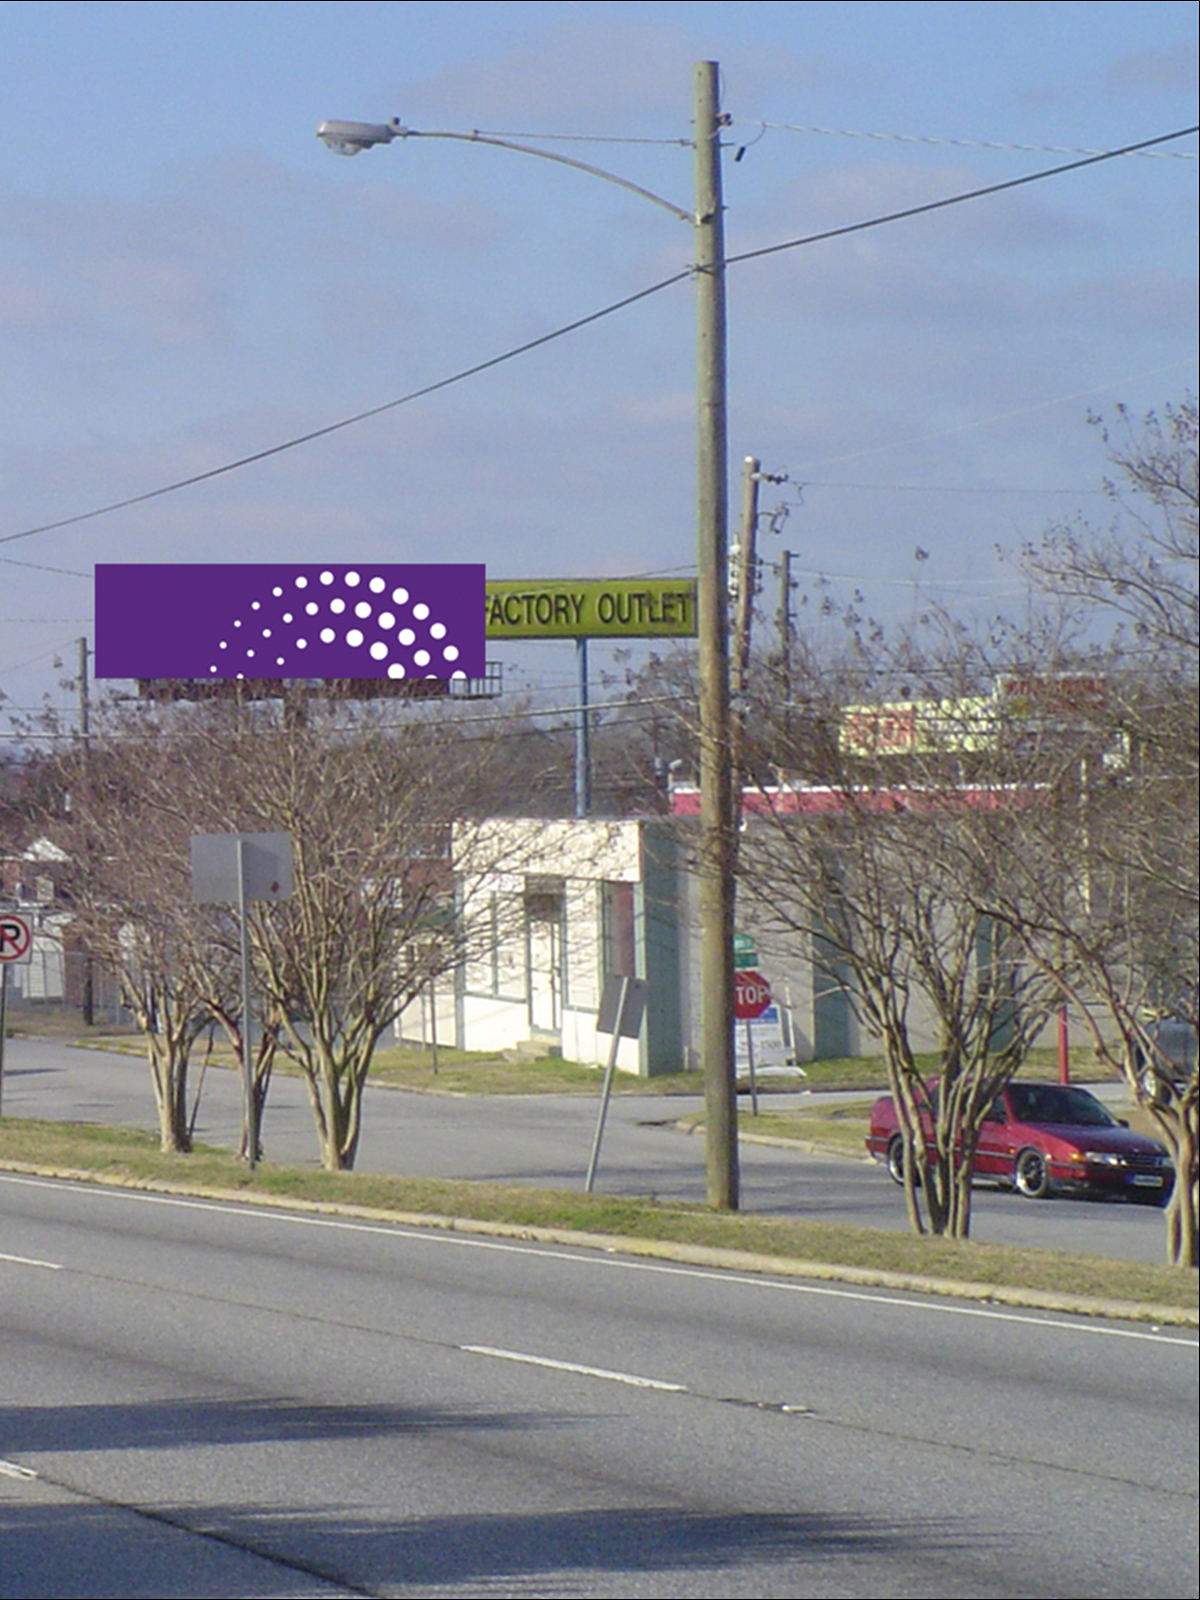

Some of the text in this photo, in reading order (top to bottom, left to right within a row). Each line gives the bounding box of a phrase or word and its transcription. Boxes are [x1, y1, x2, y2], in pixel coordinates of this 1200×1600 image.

[486, 592, 687, 624] ACTORY OUTLET
[735, 985, 767, 1005] TOP
